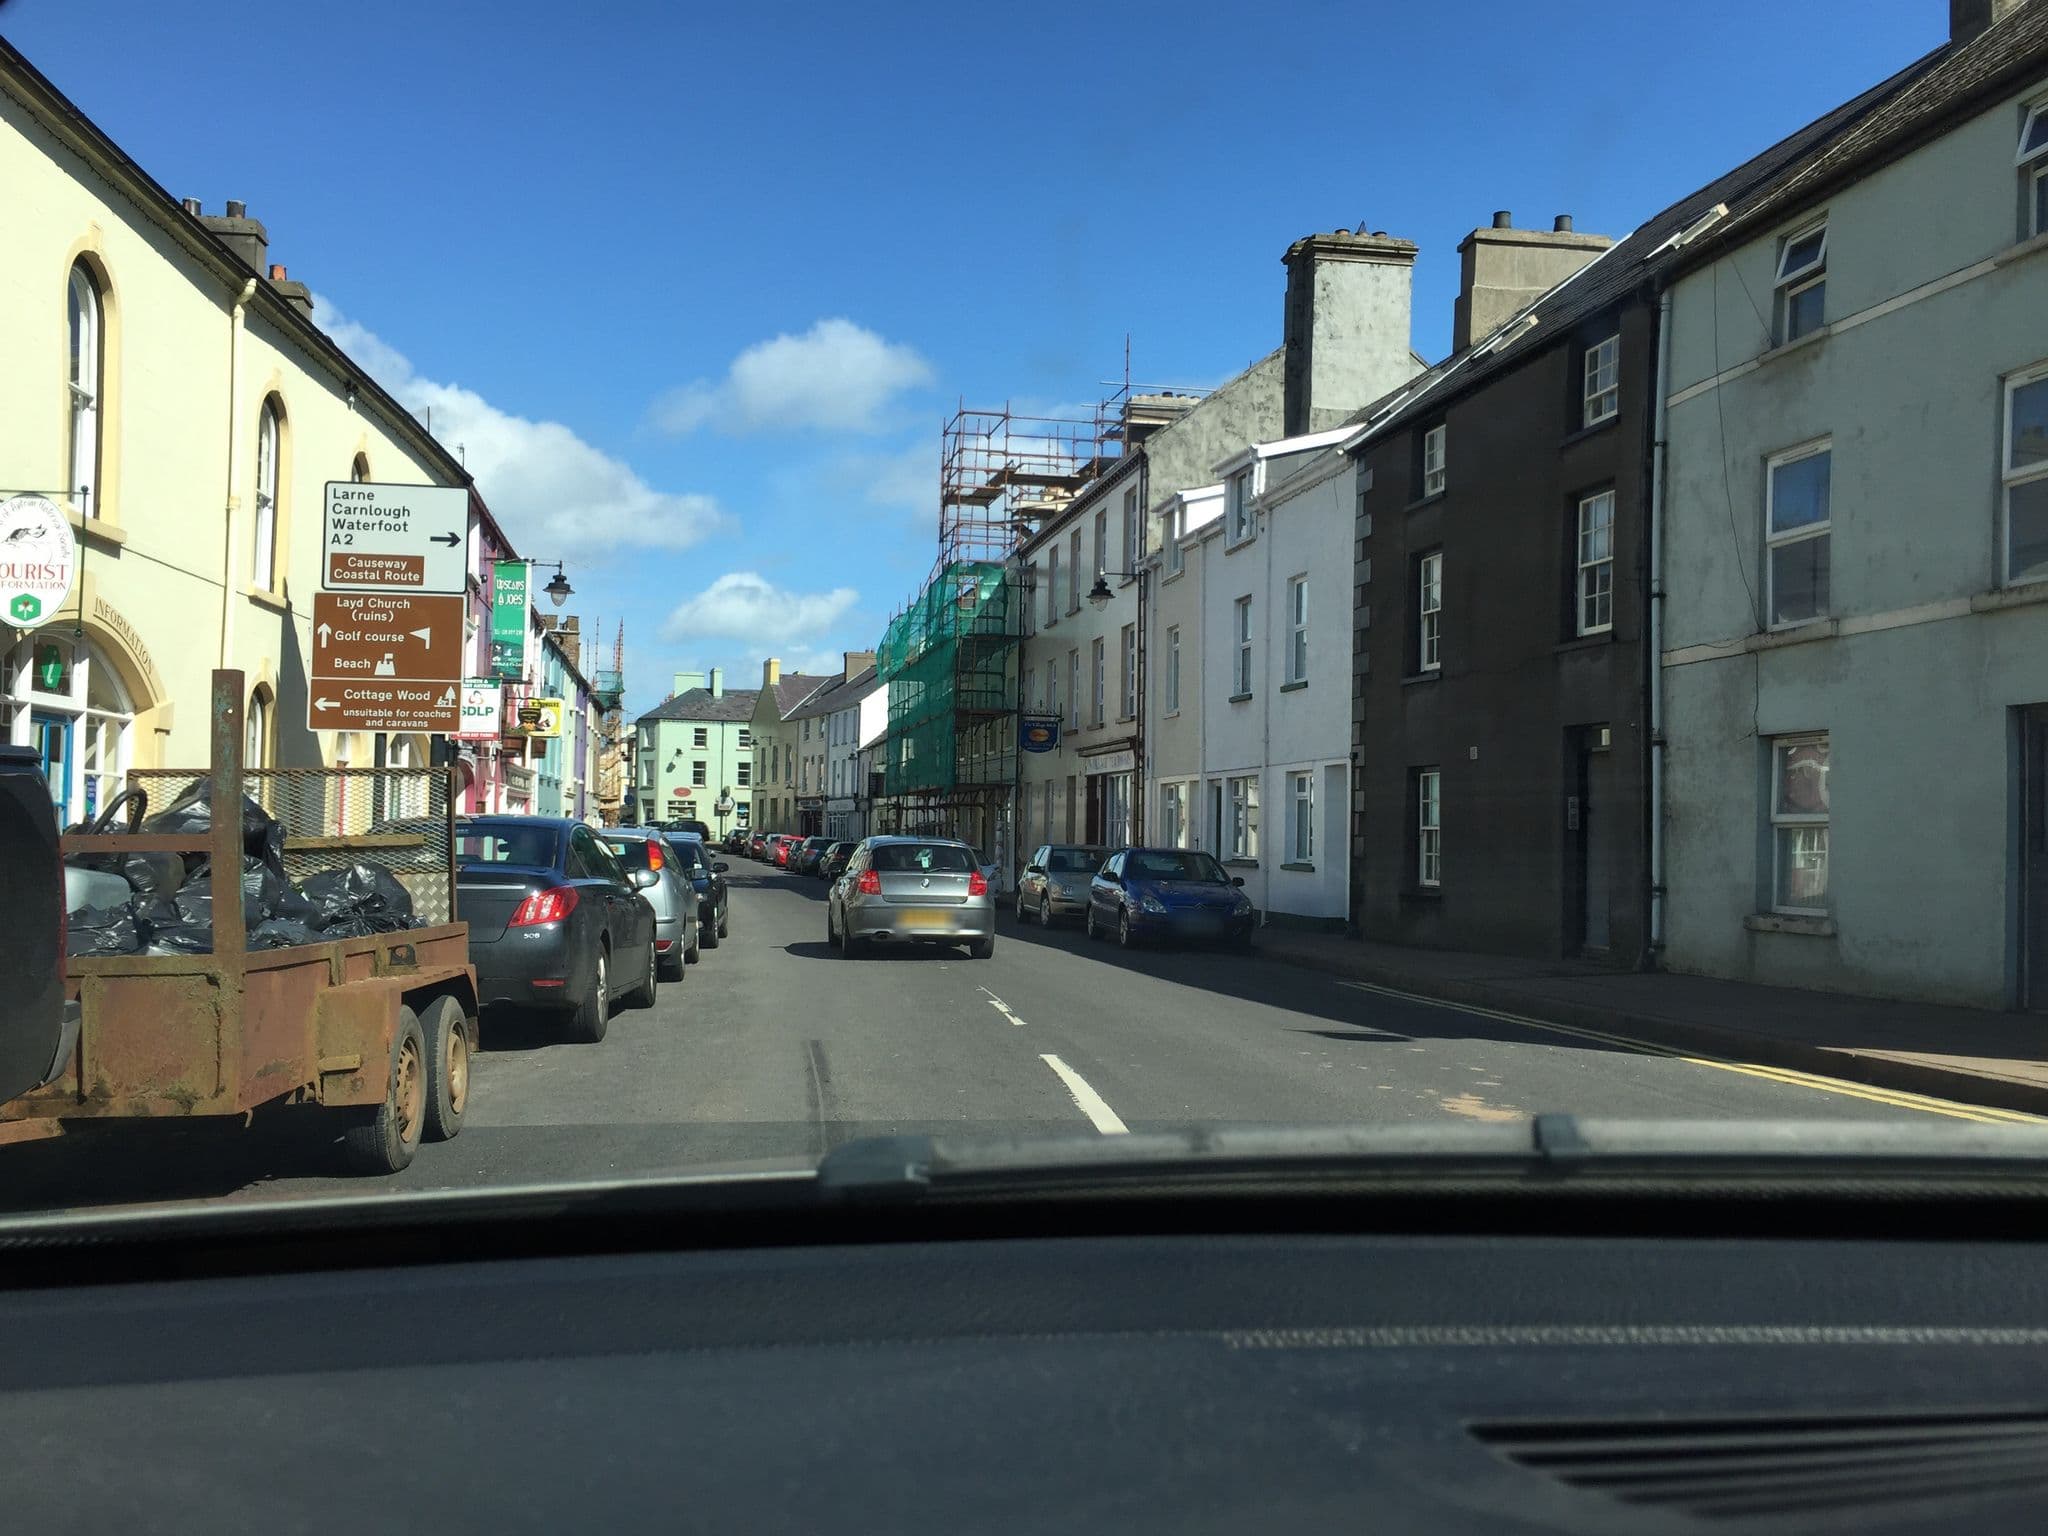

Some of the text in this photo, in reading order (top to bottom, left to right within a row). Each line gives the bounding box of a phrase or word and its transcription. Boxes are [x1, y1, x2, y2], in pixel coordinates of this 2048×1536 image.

[333, 487, 375, 501] Larne
[332, 503, 411, 519] Carnlough
[332, 518, 409, 533] Waterfoot
[331, 533, 354, 546] A2
[347, 557, 407, 571] Causeway
[334, 569, 421, 582] Coastal Route
[336, 596, 411, 610] Layd Church
[352, 609, 394, 623] (ruins)
[94, 596, 152, 675] INFORMATION
[335, 630, 405, 642] Golf course
[334, 657, 371, 669] Beach
[344, 689, 431, 702] Cottage Wood
[343, 708, 452, 719] unsuitable for coaches
[365, 719, 429, 728] and caravans
